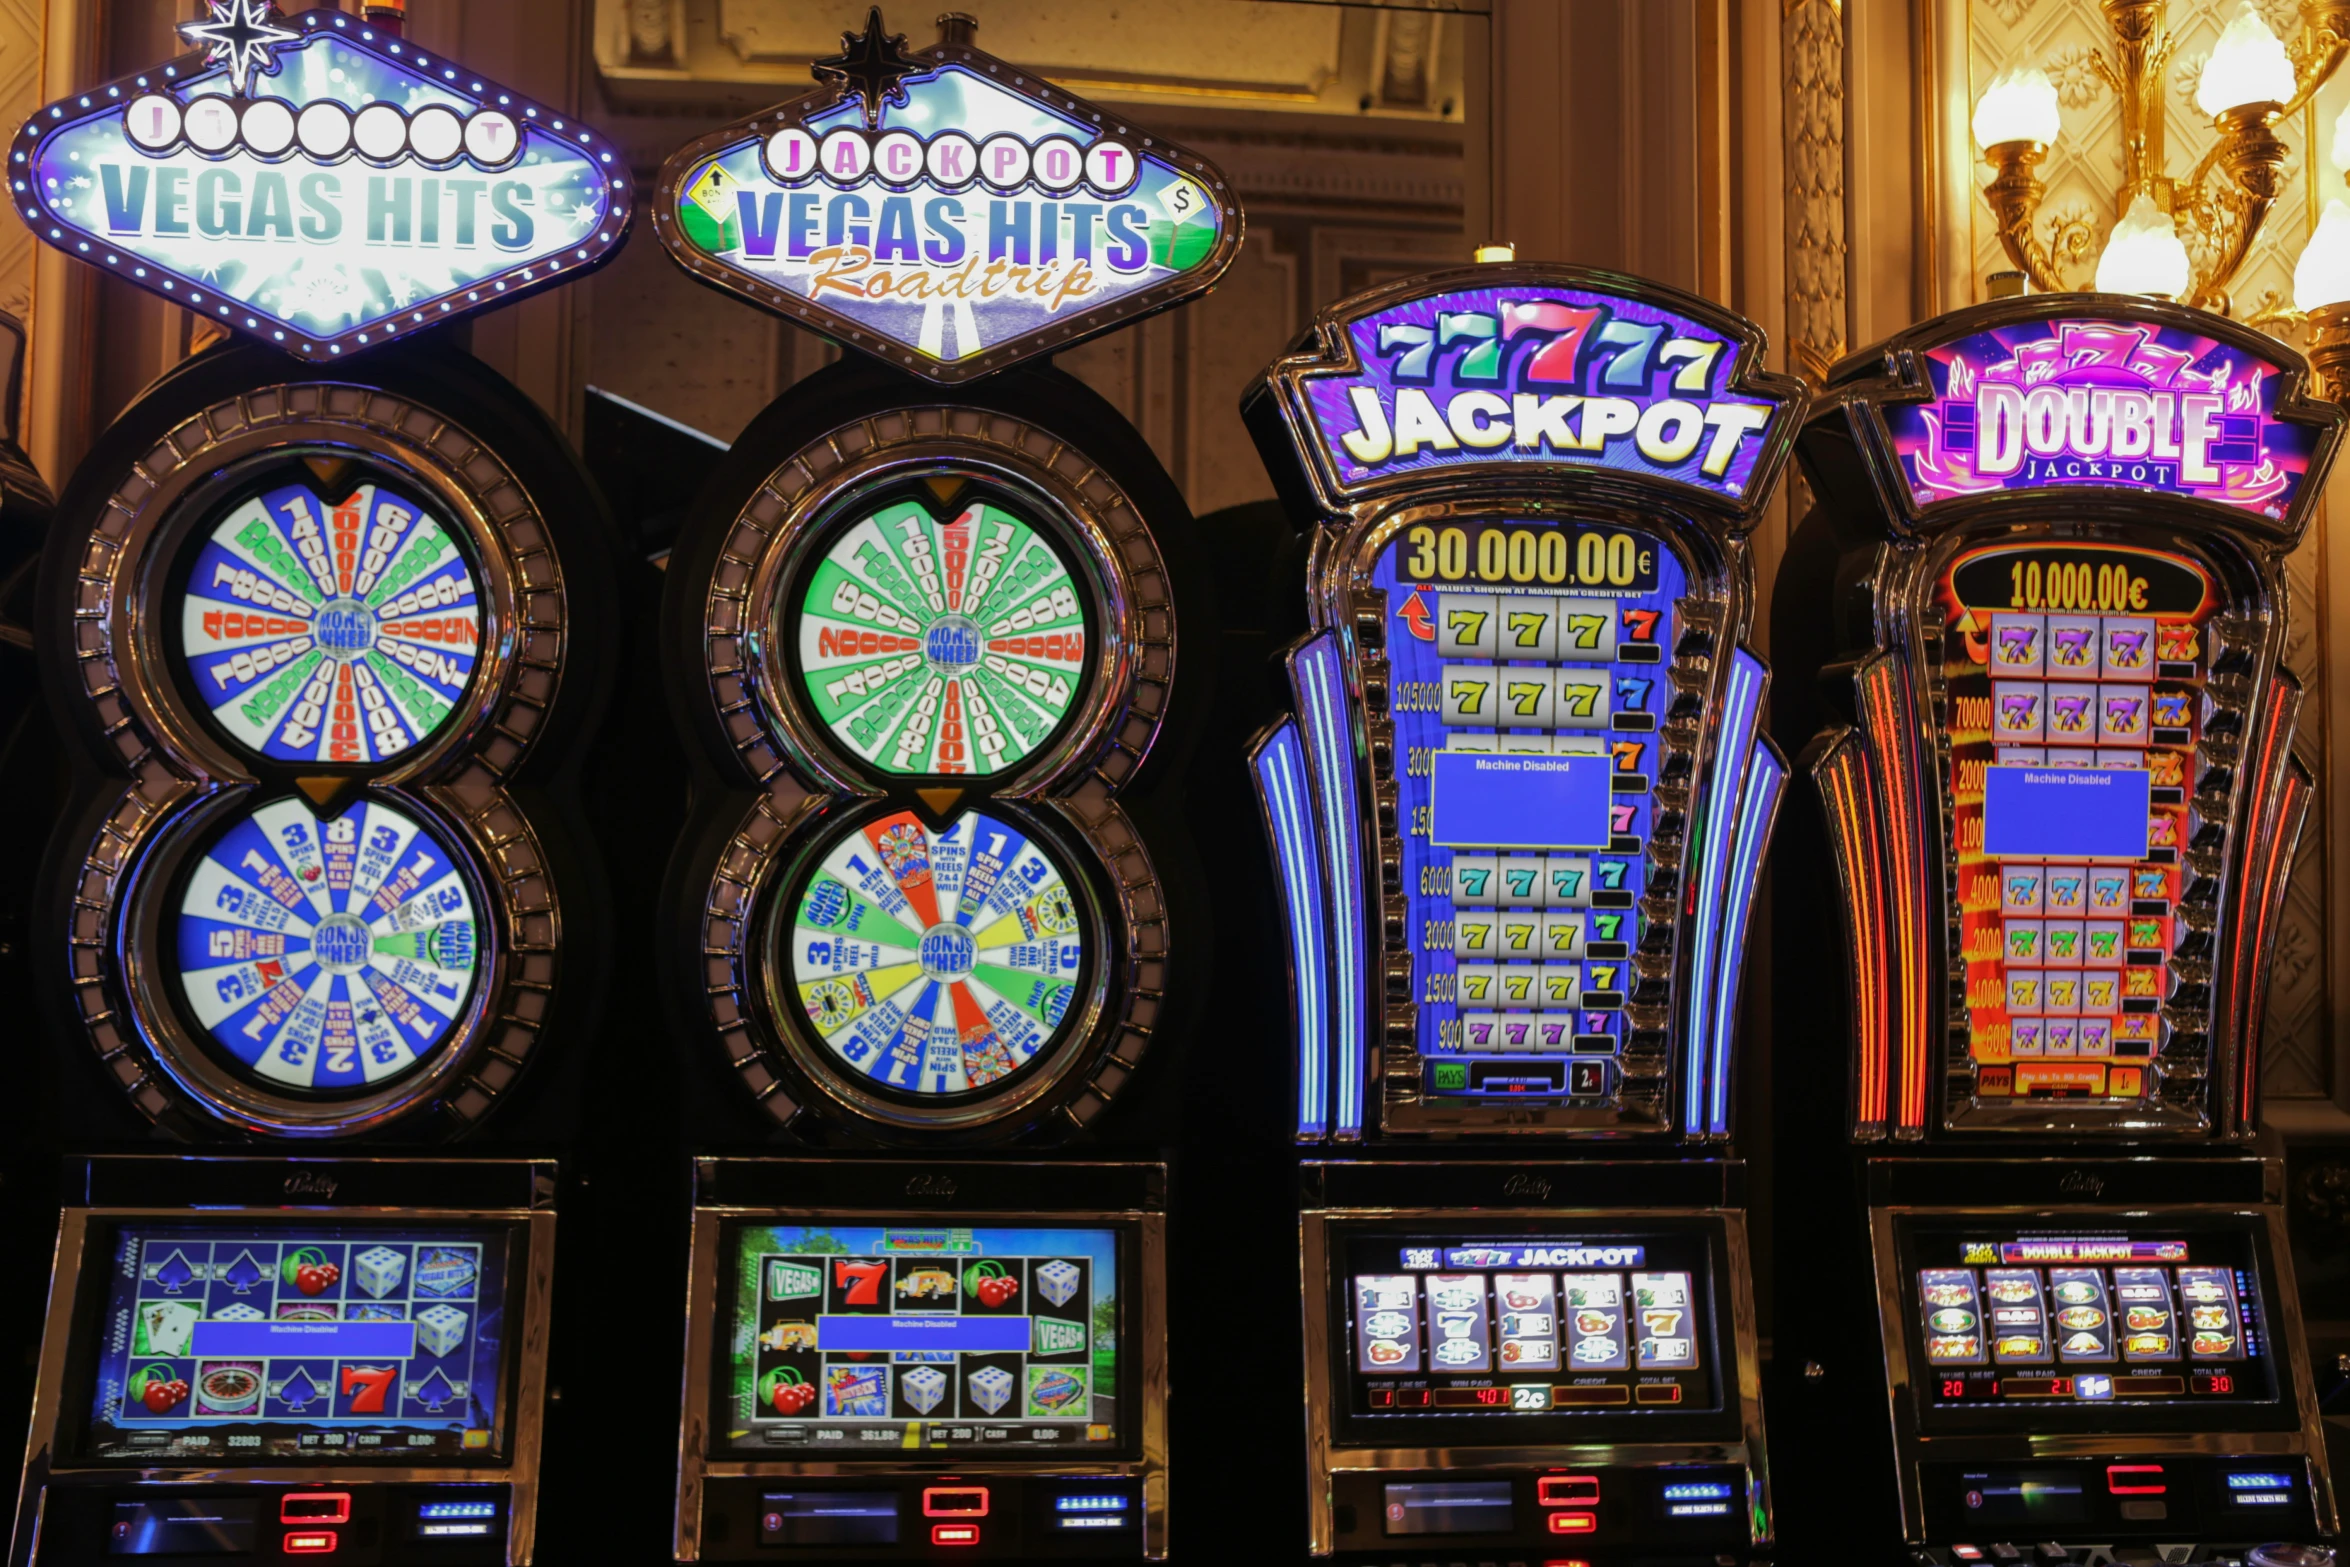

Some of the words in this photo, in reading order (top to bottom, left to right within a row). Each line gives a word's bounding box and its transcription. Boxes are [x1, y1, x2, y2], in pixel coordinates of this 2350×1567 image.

[785, 139, 1123, 184] JACKPOT
[100, 164, 343, 244] VEGAS
[366, 176, 535, 250] HITS
[737, 191, 965, 264] VEGAS
[988, 201, 1149, 270] HITS
[807, 246, 1095, 312] Roadtrip
[1340, 386, 1772, 478] JACKPOT
[1979, 385, 2224, 483] DOUBLE
[2028, 460, 2170, 484] JACKPOT
[280, 496, 336, 596] 14000
[355, 503, 412, 595] 6000
[234, 517, 322, 604] 50000
[895, 515, 944, 613] 16000
[964, 520, 1016, 614] 12000
[212, 562, 312, 617] 18000
[852, 540, 933, 623] 100000
[1528, 588, 1578, 596] MAXIMUM
[1623, 590, 1642, 598] BET
[831, 580, 921, 634] 6000
[990, 586, 1078, 636] 8000
[203, 610, 309, 640] 40000
[819, 627, 920, 658] 20000
[988, 632, 1083, 661] 30000
[210, 637, 311, 690] 10000
[377, 638, 471, 689] 12000
[825, 654, 922, 707] 14000
[985, 655, 1071, 709] 4000
[280, 659, 336, 749] 4000
[355, 664, 409, 756] 8000
[846, 666, 930, 751] 50000
[975, 668, 1051, 746] 200000
[1396, 681, 1441, 712] 105000
[329, 663, 360, 761] 30000
[892, 677, 943, 771] 18000
[963, 678, 1014, 772] 10000
[1956, 697, 1990, 729] 70000
[1476, 760, 1520, 771] Machine
[1523, 760, 1569, 772] Disabled
[2024, 773, 2066, 784] Machine
[2068, 773, 2111, 785] Disabled
[371, 825, 399, 852] 3
[932, 846, 965, 856] SPINS
[989, 832, 1008, 857] 1
[935, 863, 962, 871] REELS
[976, 852, 1004, 871] SPIN
[1020, 857, 1047, 884] 3
[859, 867, 884, 891] SPIN
[968, 866, 997, 887] REELS
[1006, 869, 1034, 899] SPINS
[1421, 866, 1450, 896] 6000
[1970, 875, 1999, 904] 4000
[875, 884, 892, 899] ALL
[965, 889, 981, 900] ALL
[846, 903, 867, 931] SPIN
[889, 898, 908, 916] PAYS
[988, 898, 1005, 915] ONLY
[1424, 921, 1454, 951] 3000
[1974, 928, 2000, 957] 2000
[807, 942, 831, 965] 3
[833, 937, 844, 972] SPINS
[850, 945, 859, 966] REEL
[870, 945, 880, 968] WILD
[921, 953, 972, 972] WHEEL
[1028, 946, 1037, 967] ONE
[1050, 940, 1058, 974] SPINS
[1027, 980, 1046, 1008] SPIN
[1425, 973, 1455, 1004] 1500
[1975, 979, 2001, 1008] 1000
[855, 1021, 884, 1050] SPINS
[902, 1023, 929, 1041] POKER
[907, 1014, 931, 1030] CHIPS
[934, 1027, 956, 1035] WILD
[1007, 1020, 1035, 1048] SPINS
[1439, 1020, 1461, 1049] 900
[843, 1035, 870, 1062] 8
[891, 1047, 919, 1065] SPIN
[930, 1046, 957, 1056] REELS
[930, 1063, 956, 1072] SPIN
[1438, 1070, 1464, 1085] PAYS
[1981, 1075, 2009, 1087] PAYS
[1504, 1174, 1552, 1200] Bally
[2060, 1170, 2104, 1196] Bally
[1517, 1249, 1638, 1266] JACKPOT
[2022, 1245, 2074, 1260] DOUBLE
[2078, 1246, 2132, 1260] JACKPOT
[775, 1268, 813, 1295] VEGAS
[270, 1325, 303, 1333] Machine
[304, 1325, 338, 1333] Disabled
[892, 1320, 924, 1328] Machine
[1039, 1321, 1078, 1351] VEGAS
[2036, 1370, 2056, 1378] PAID
[2051, 1380, 2071, 1394] 21
[2211, 1377, 2229, 1391] 30
[1943, 1381, 1963, 1397] 20
[183, 1436, 210, 1446] PAID
[302, 1435, 319, 1444] BET
[817, 1430, 843, 1440] PAID
[932, 1430, 948, 1439] BET
[985, 1430, 1007, 1439] CASH
[2236, 1495, 2255, 1504] RECEIVE
